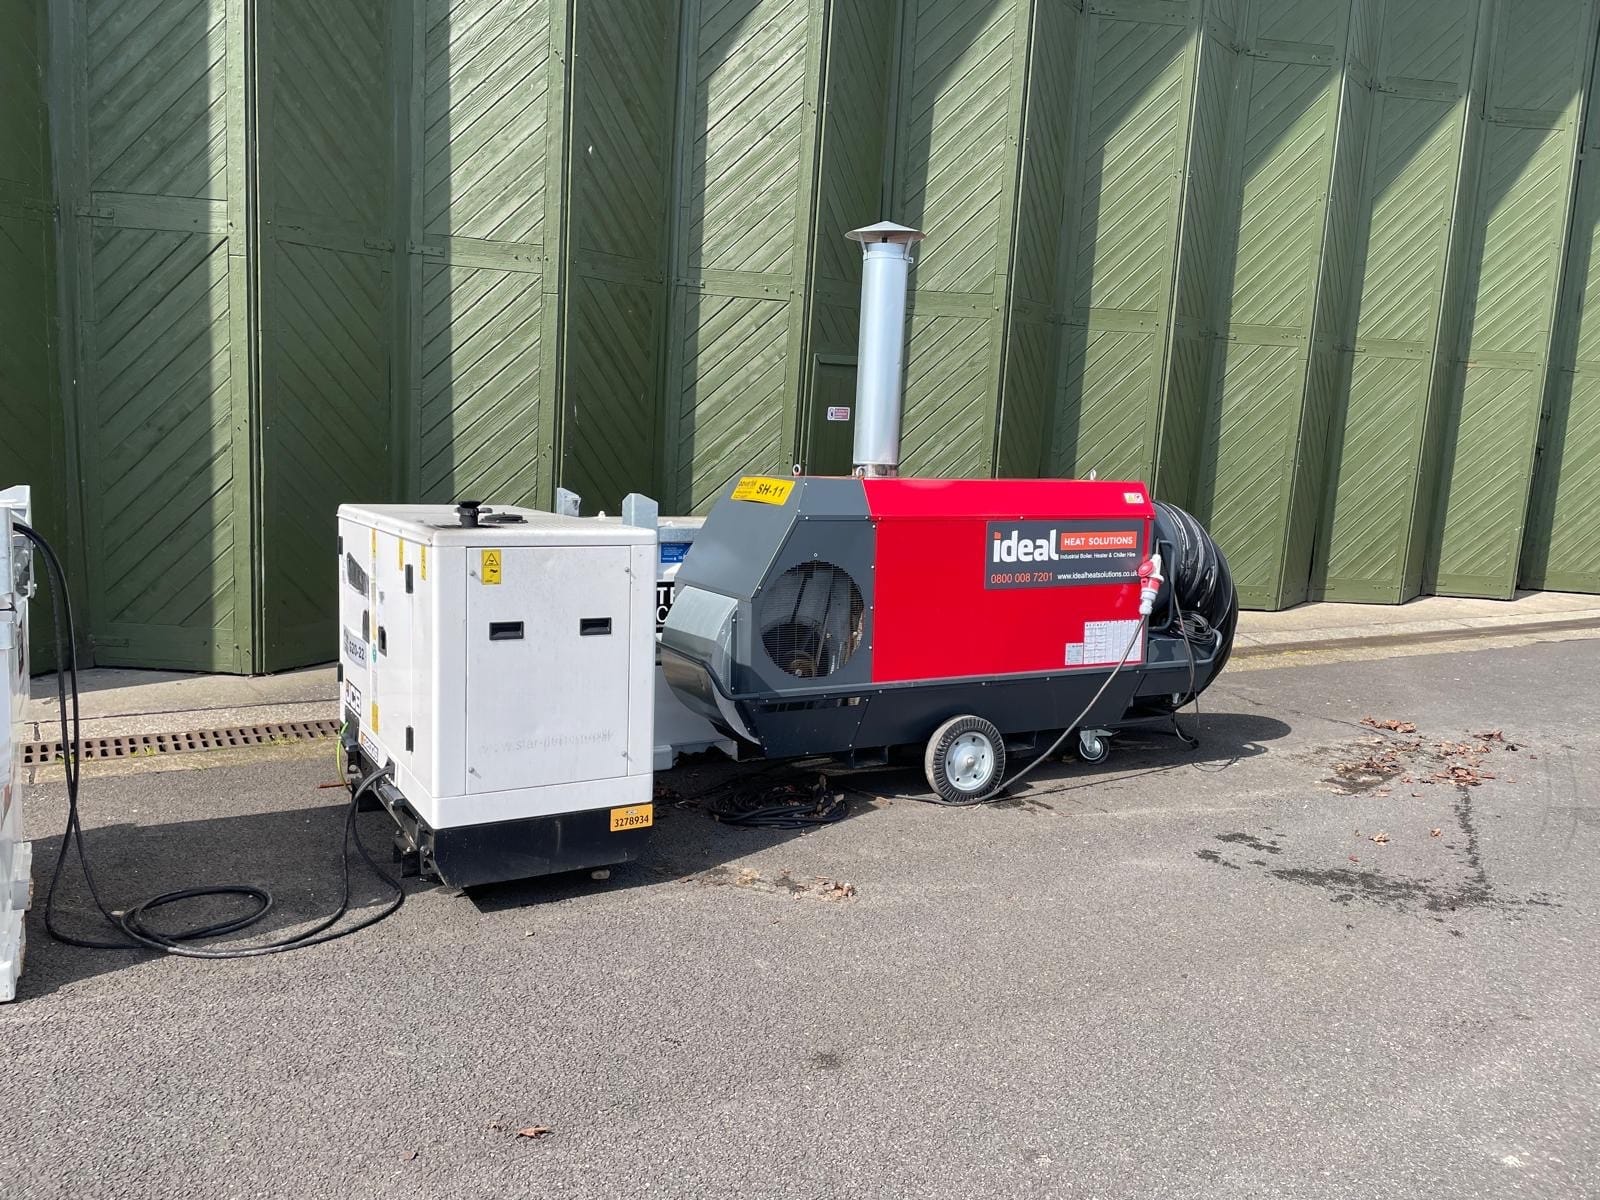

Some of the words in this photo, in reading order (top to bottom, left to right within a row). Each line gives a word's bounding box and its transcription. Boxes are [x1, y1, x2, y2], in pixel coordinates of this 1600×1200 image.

[757, 484, 784, 498] SH-11
[993, 529, 1059, 563] ideal
[1064, 537, 1085, 546] HEAT
[1088, 536, 1133, 545] SOLUTIONS
[990, 573, 1013, 584] 0800
[1014, 572, 1031, 583] 008
[1033, 571, 1053, 582] 7201
[1057, 570, 1138, 580] www.idealheatsolutions.co.uk
[614, 815, 649, 828] 3278934
